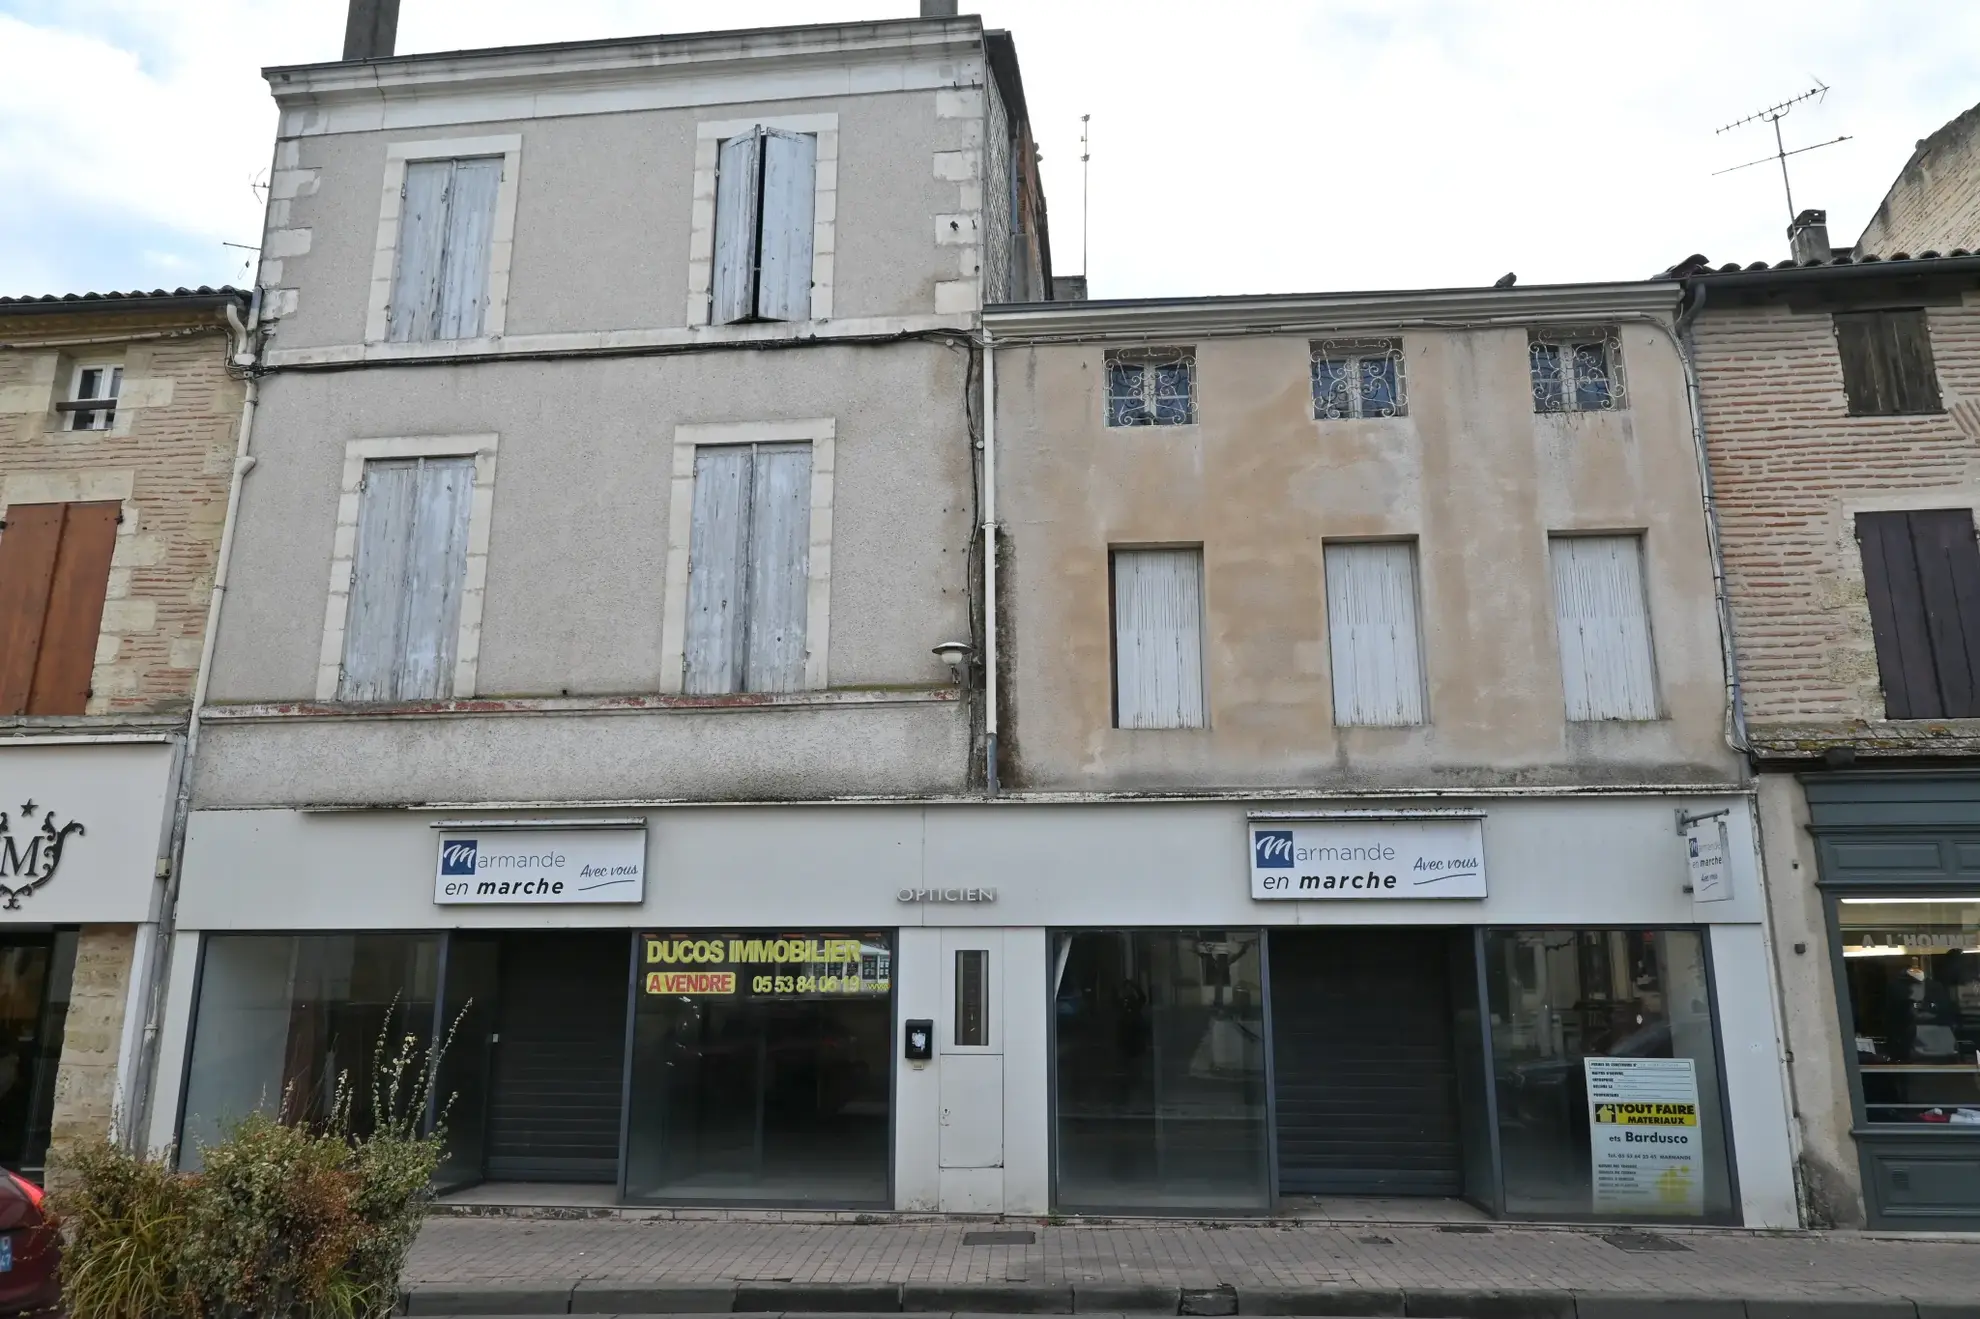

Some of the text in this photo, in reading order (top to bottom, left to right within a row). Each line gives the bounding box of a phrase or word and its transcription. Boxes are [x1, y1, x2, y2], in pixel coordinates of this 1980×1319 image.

[443, 844, 566, 869] Marmande
[1256, 836, 1395, 861] Marmande
[580, 863, 638, 878] Avec vous
[1413, 857, 1479, 871] Avec vous
[445, 878, 564, 895] en marche
[1263, 871, 1397, 890] en marche
[897, 887, 994, 902] OPTICIEN
[647, 939, 861, 963] DUCOS IMMOBILIER
[649, 974, 732, 993] A VENDRE
[753, 975, 773, 992] 05
[774, 975, 795, 993] 53
[796, 975, 817, 993] 84
[841, 975, 860, 993] 19
[1617, 1103, 1694, 1115] TOUT FAIRE
[1628, 1116, 1685, 1125] MATERIAUX
[1609, 1131, 1688, 1144] ets Bardusco
